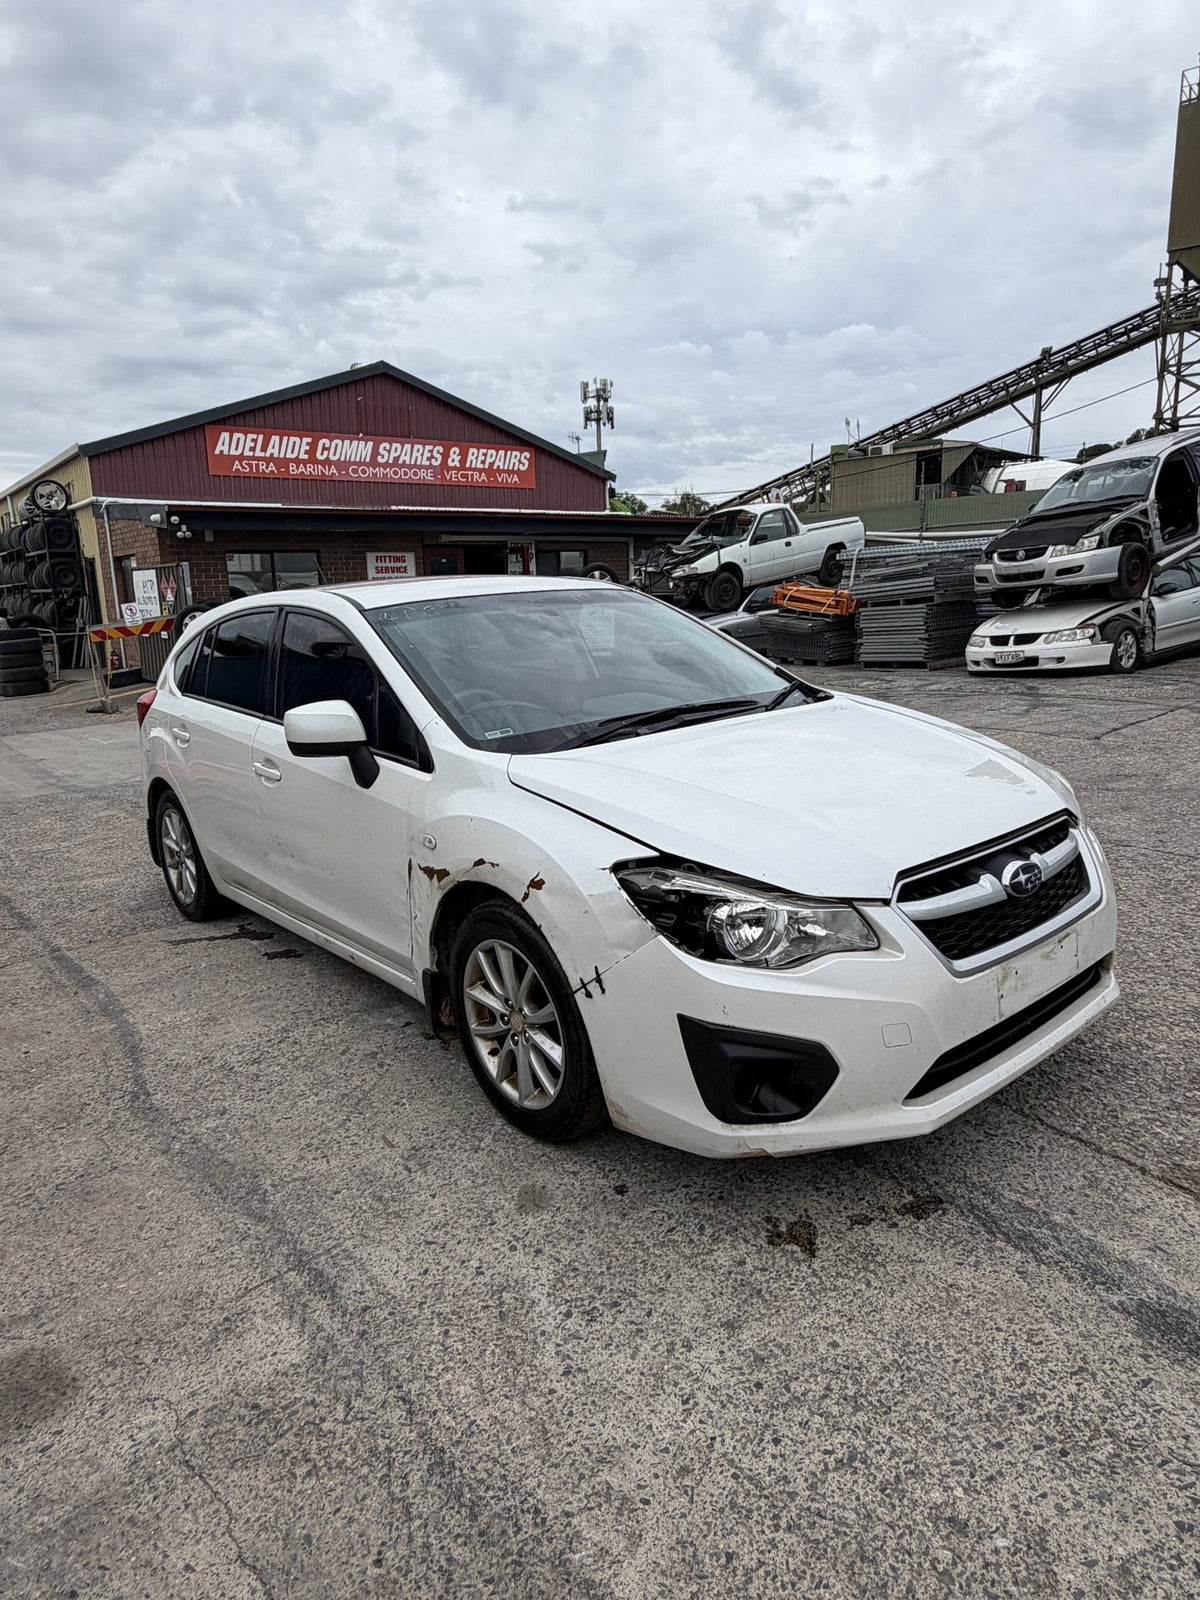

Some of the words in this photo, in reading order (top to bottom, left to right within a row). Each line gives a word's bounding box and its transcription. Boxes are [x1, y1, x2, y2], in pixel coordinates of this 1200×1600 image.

[214, 431, 312, 460] ADELAIDE
[316, 438, 373, 463] COMM
[377, 442, 443, 466] SPARES
[448, 447, 462, 467] &
[466, 448, 530, 471] REPAIRS
[232, 460, 278, 474] ASTRA
[289, 463, 338, 476] BARINA
[349, 466, 434, 480] COMMODORE
[444, 470, 488, 483] VECTRA
[496, 473, 520, 484] VIVA
[375, 555, 406, 563] FITTING
[374, 565, 409, 574] SERVICE
